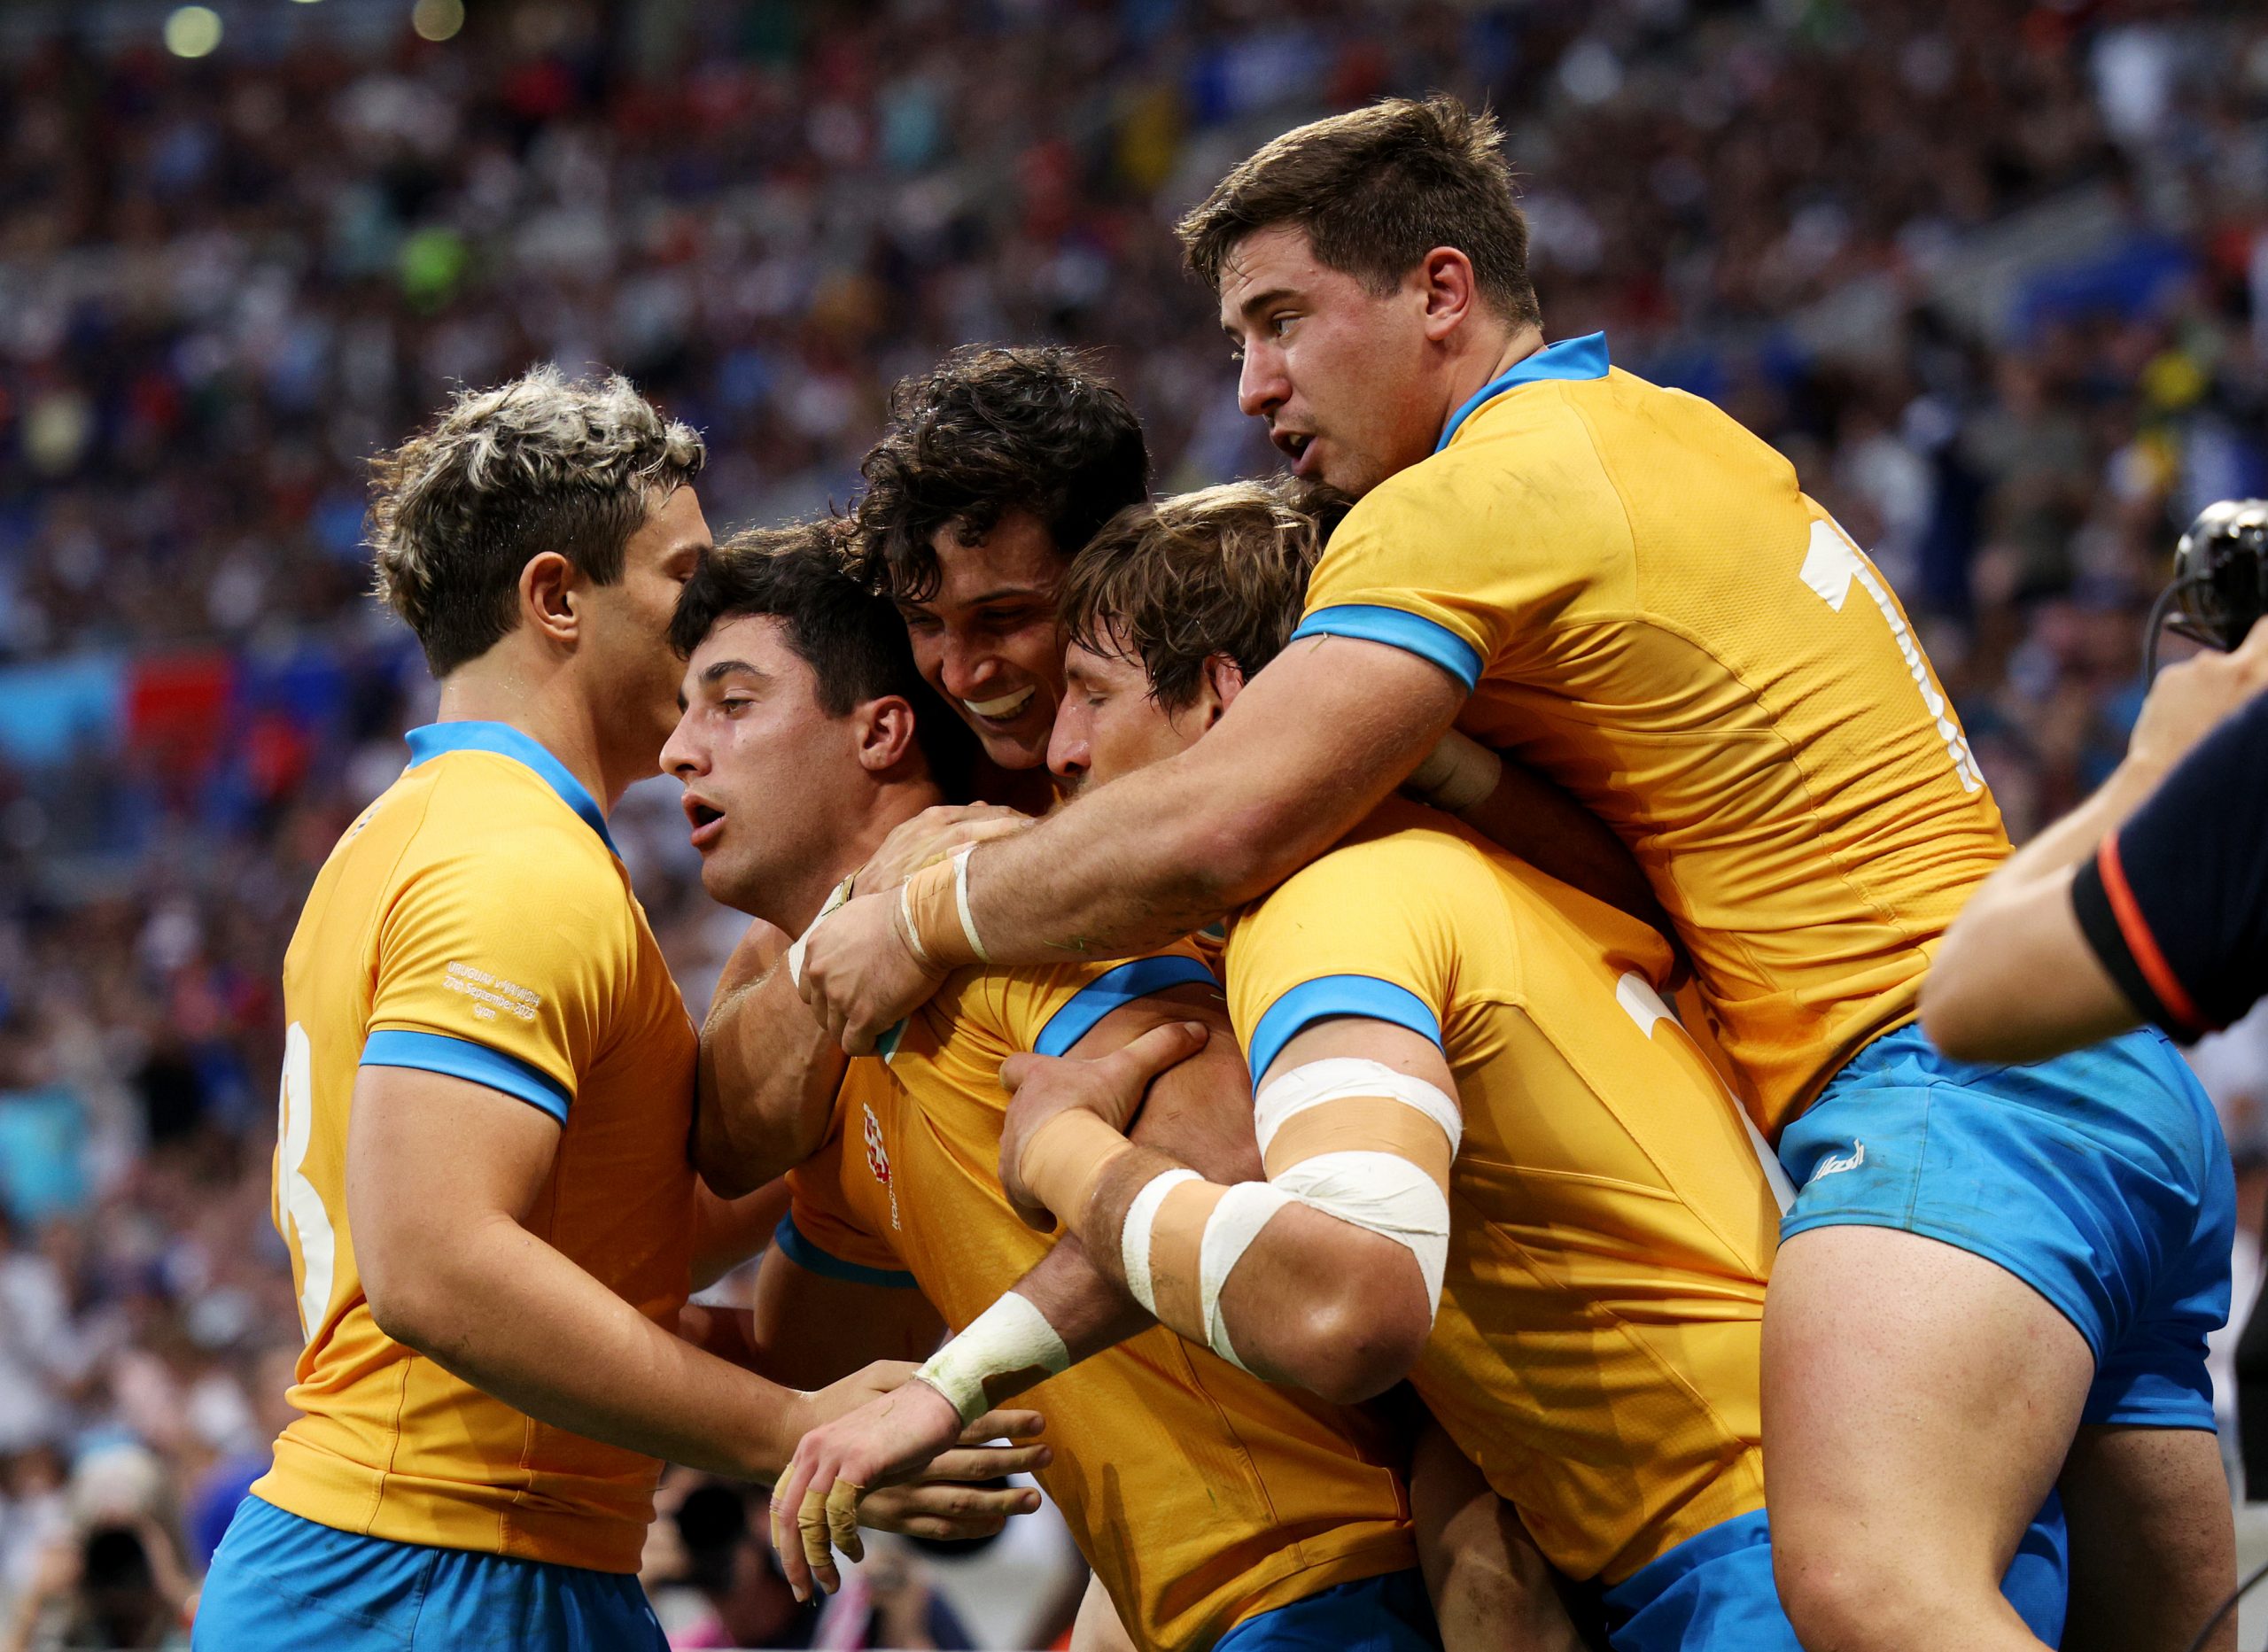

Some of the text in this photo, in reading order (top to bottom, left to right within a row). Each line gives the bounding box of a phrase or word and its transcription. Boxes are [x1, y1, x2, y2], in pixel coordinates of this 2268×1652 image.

[1798, 514, 1986, 795] 1
[447, 960, 495, 985] URUGUAY
[443, 975, 536, 1020] 27th September 2023
